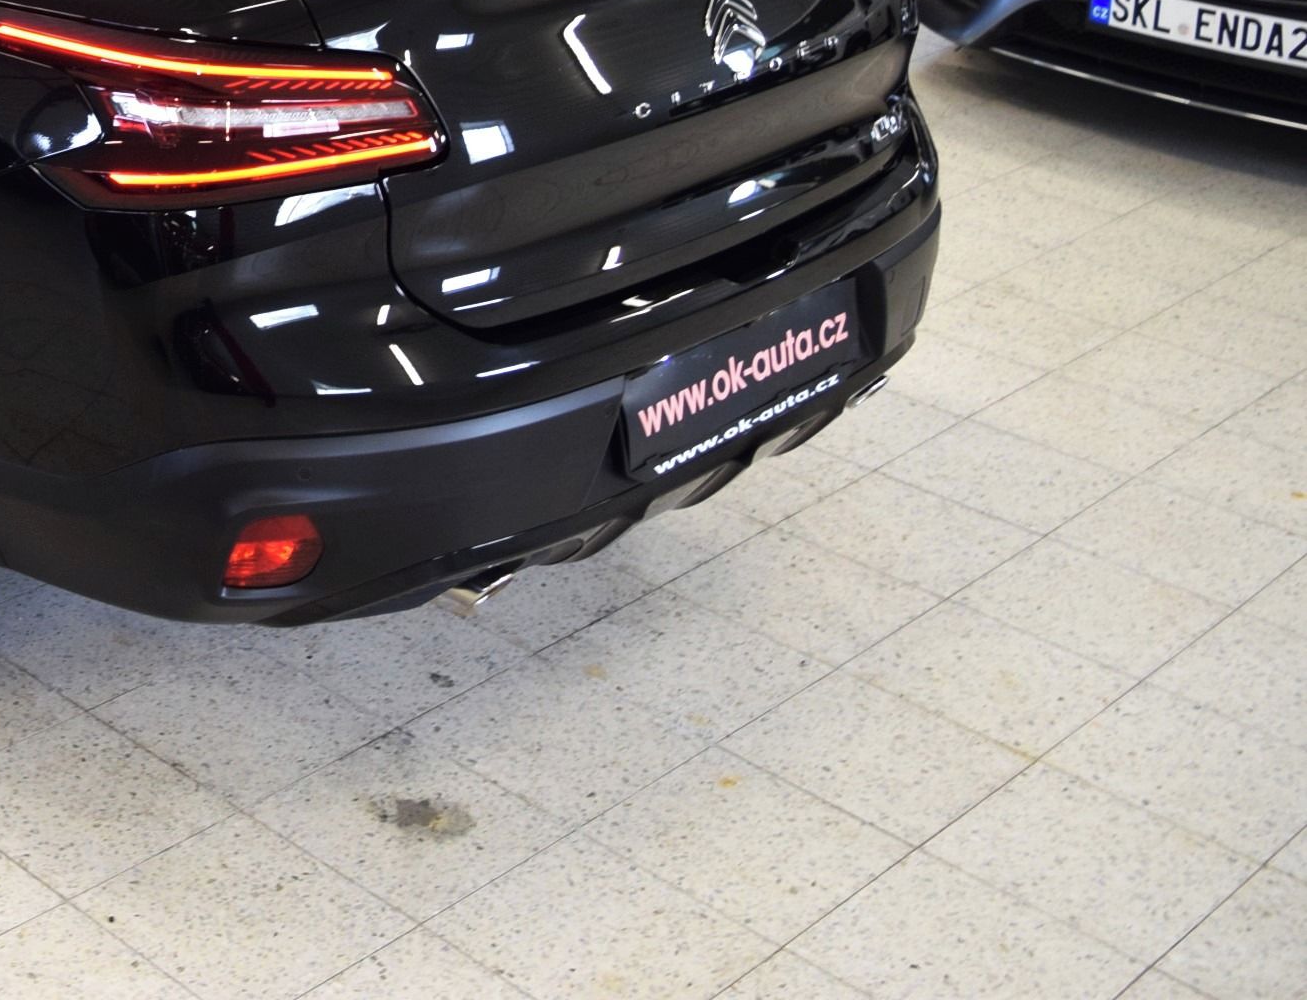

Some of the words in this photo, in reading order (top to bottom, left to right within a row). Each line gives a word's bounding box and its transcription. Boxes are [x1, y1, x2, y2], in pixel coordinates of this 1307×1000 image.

[1092, 6, 1109, 19] CZ
[1194, 8, 1307, 62] ENDA2
[637, 312, 849, 438] www.ok-auta.cz
[654, 373, 840, 475] www.ok-auta.cz
